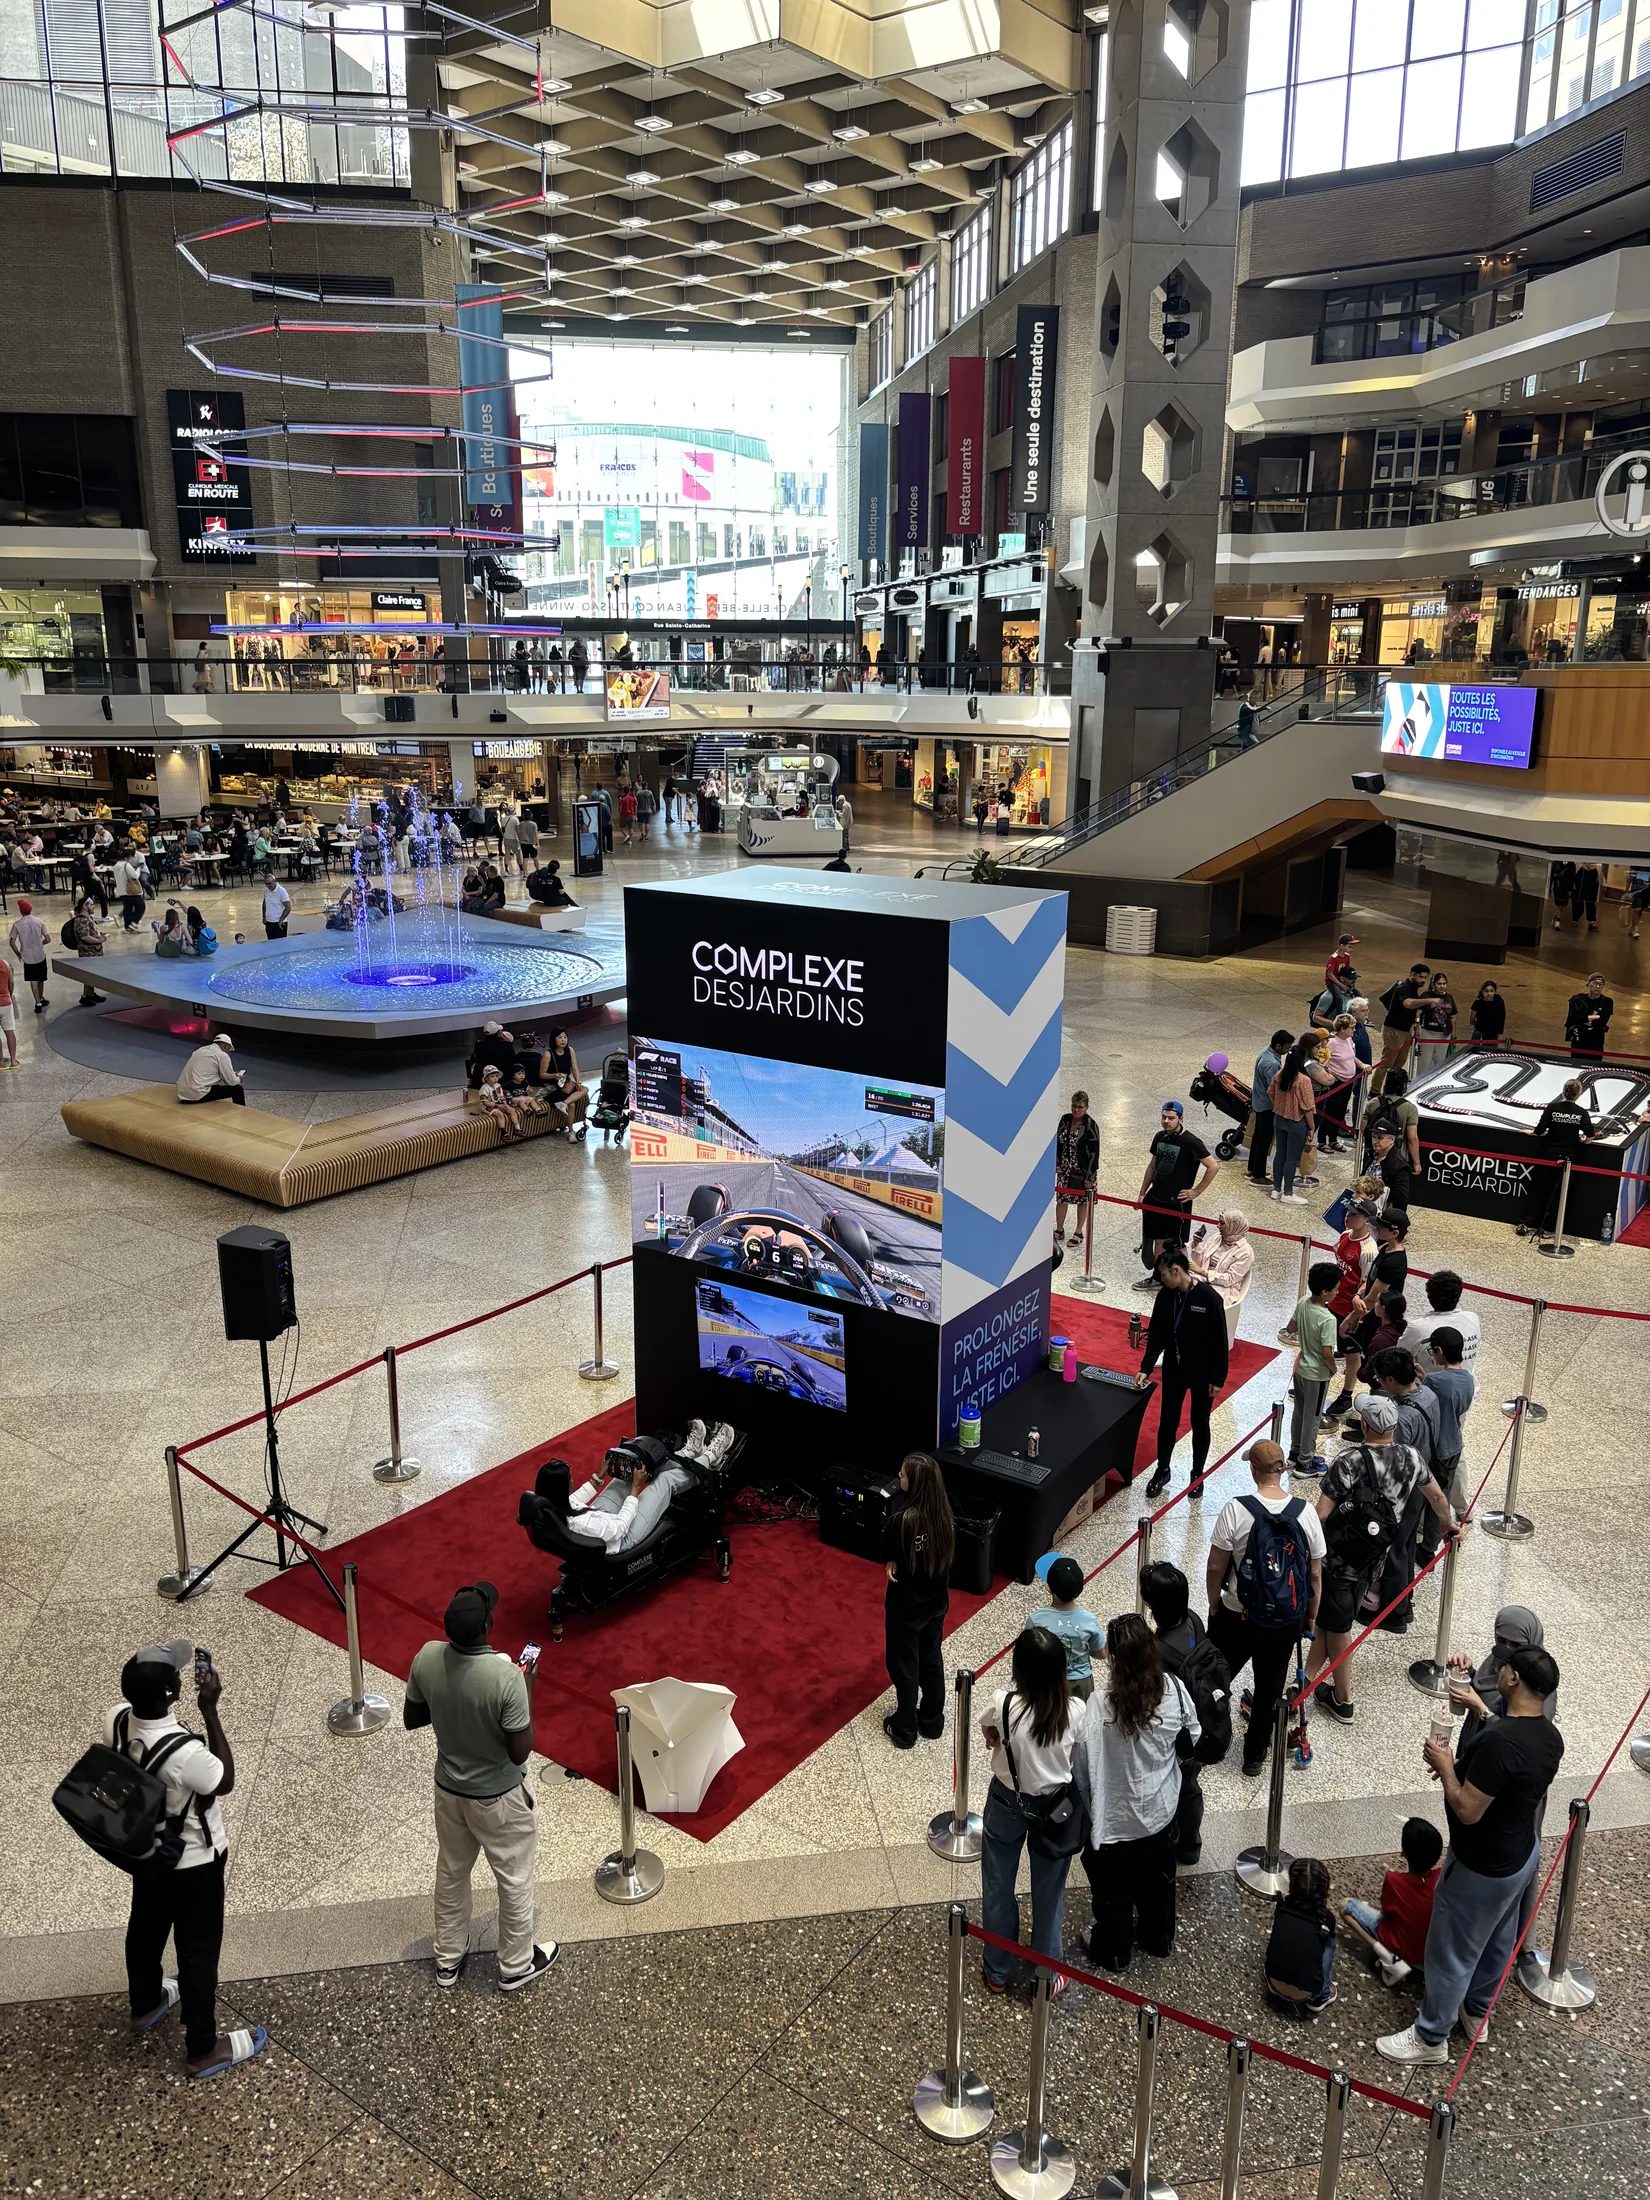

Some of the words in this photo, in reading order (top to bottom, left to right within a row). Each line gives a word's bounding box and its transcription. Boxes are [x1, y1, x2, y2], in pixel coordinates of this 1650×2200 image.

[1027, 321, 1045, 419] destination
[1026, 422, 1040, 467] seule
[959, 437, 972, 526] Restaurants
[1023, 471, 1038, 503] Une
[187, 489, 203, 497] EN
[204, 489, 239, 499] ROUTE
[908, 485, 918, 540] Services
[867, 496, 880, 554] Boutiques
[377, 595, 397, 605] Claire
[398, 596, 422, 606] France
[1517, 584, 1578, 600] TENDANCES
[1340, 603, 1359, 618] mini
[1451, 692, 1481, 705] TOUTES
[1481, 693, 1496, 706] LES
[1449, 705, 1501, 722] POSSIBILITÉS,
[1448, 721, 1471, 734] JUSTE
[1471, 721, 1485, 734] ICI.
[488, 741, 543, 759] BOULANGERIE
[691, 940, 864, 993] COMPLEXE
[693, 975, 864, 1027] DESJARDINS
[660, 1056, 678, 1065] RACE
[630, 1129, 667, 1158] ELLI
[696, 1143, 716, 1160] PIRELLI
[1428, 1148, 1535, 1181] COMPLEX
[853, 1179, 871, 1194] PIRELLI
[1427, 1166, 1528, 1197] DESJARDIN
[890, 1187, 934, 1215] PIRELLI
[717, 1236, 739, 1247] FxPro
[772, 1251, 780, 1263] 6
[814, 1260, 838, 1272] FxPro
[953, 1287, 1040, 1365] PROLONGEZ
[952, 1370, 972, 1397] LA
[975, 1317, 1042, 1380] FRÉNÉSIE,
[999, 1362, 1021, 1394] ICI.
[1434, 1733, 1448, 1742] Tim
